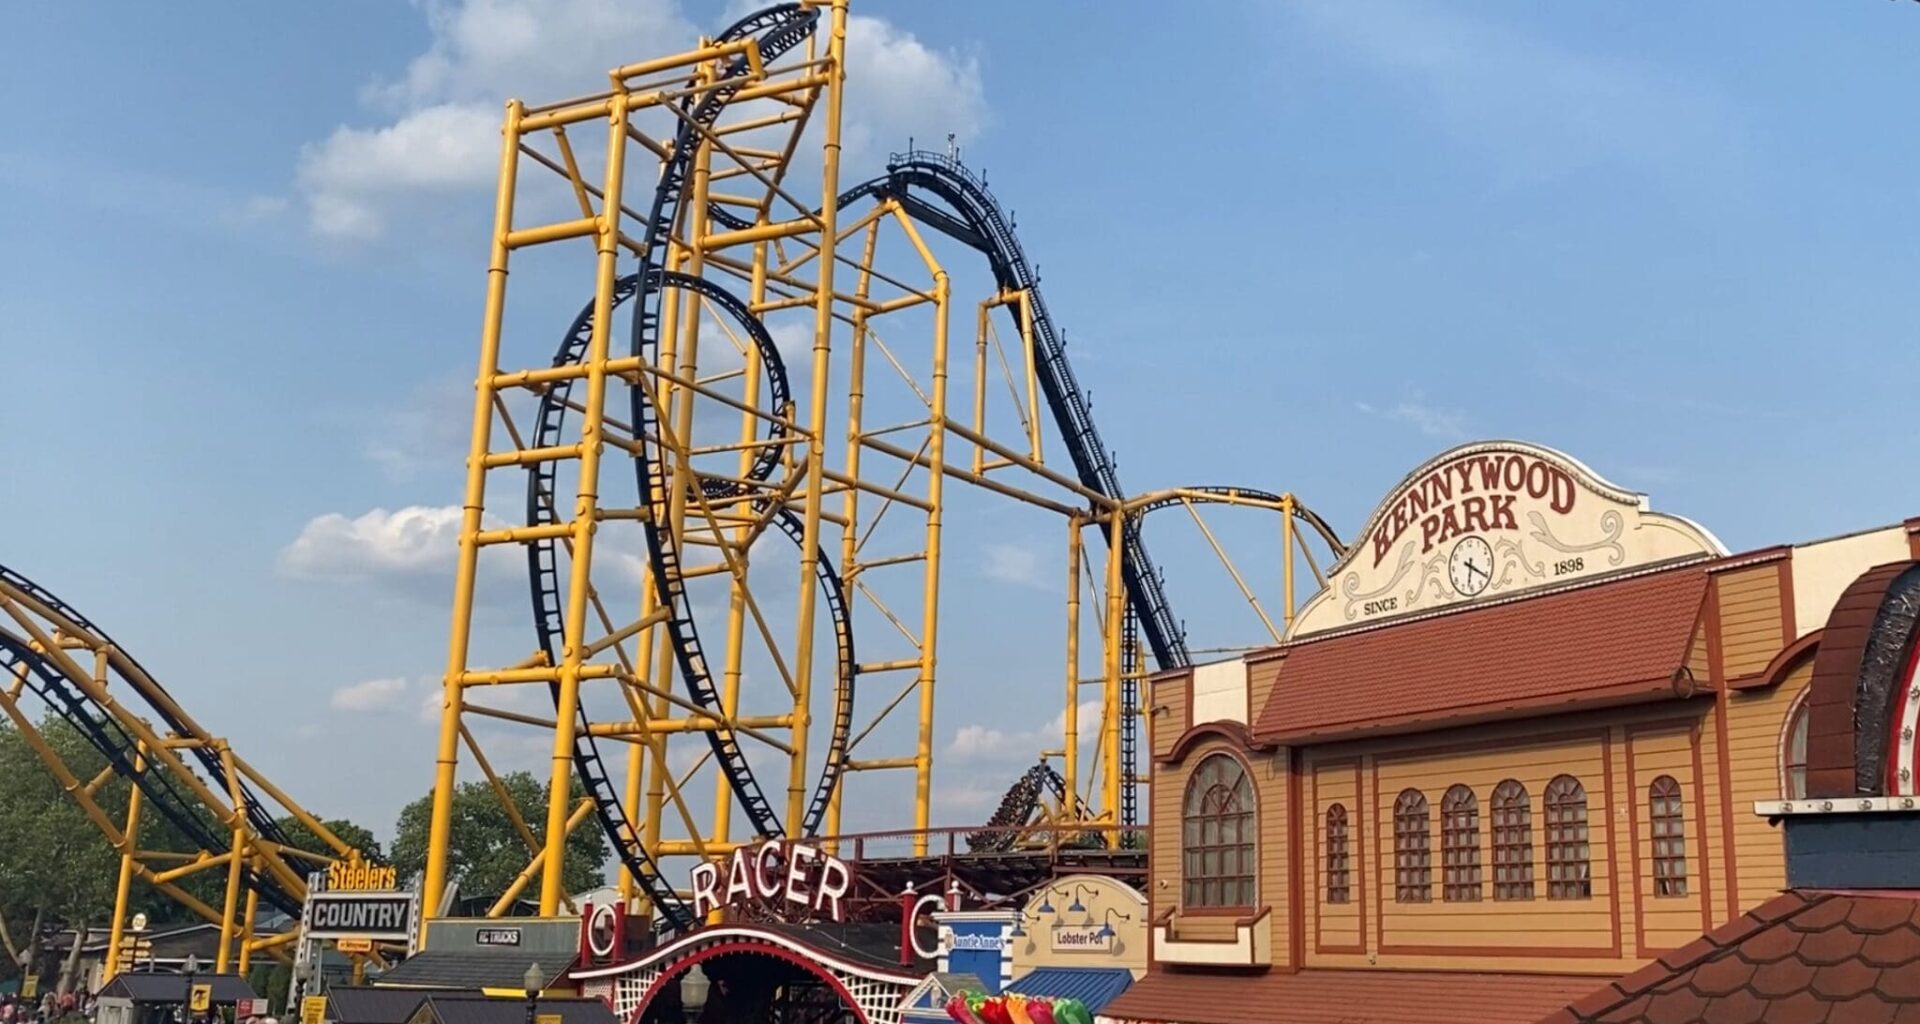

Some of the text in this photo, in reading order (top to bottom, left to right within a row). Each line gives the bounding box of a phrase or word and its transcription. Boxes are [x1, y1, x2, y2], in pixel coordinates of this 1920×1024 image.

[1372, 455, 1576, 569] KENNYWOOD
[1420, 495, 1518, 554] PARK
[1553, 558, 1585, 576] 1898
[1363, 597, 1398, 616] SINCE
[327, 860, 397, 890] Steelers
[690, 840, 850, 923] RACER
[313, 903, 406, 928] COUNTRY
[1057, 932, 1088, 945] Lobster
